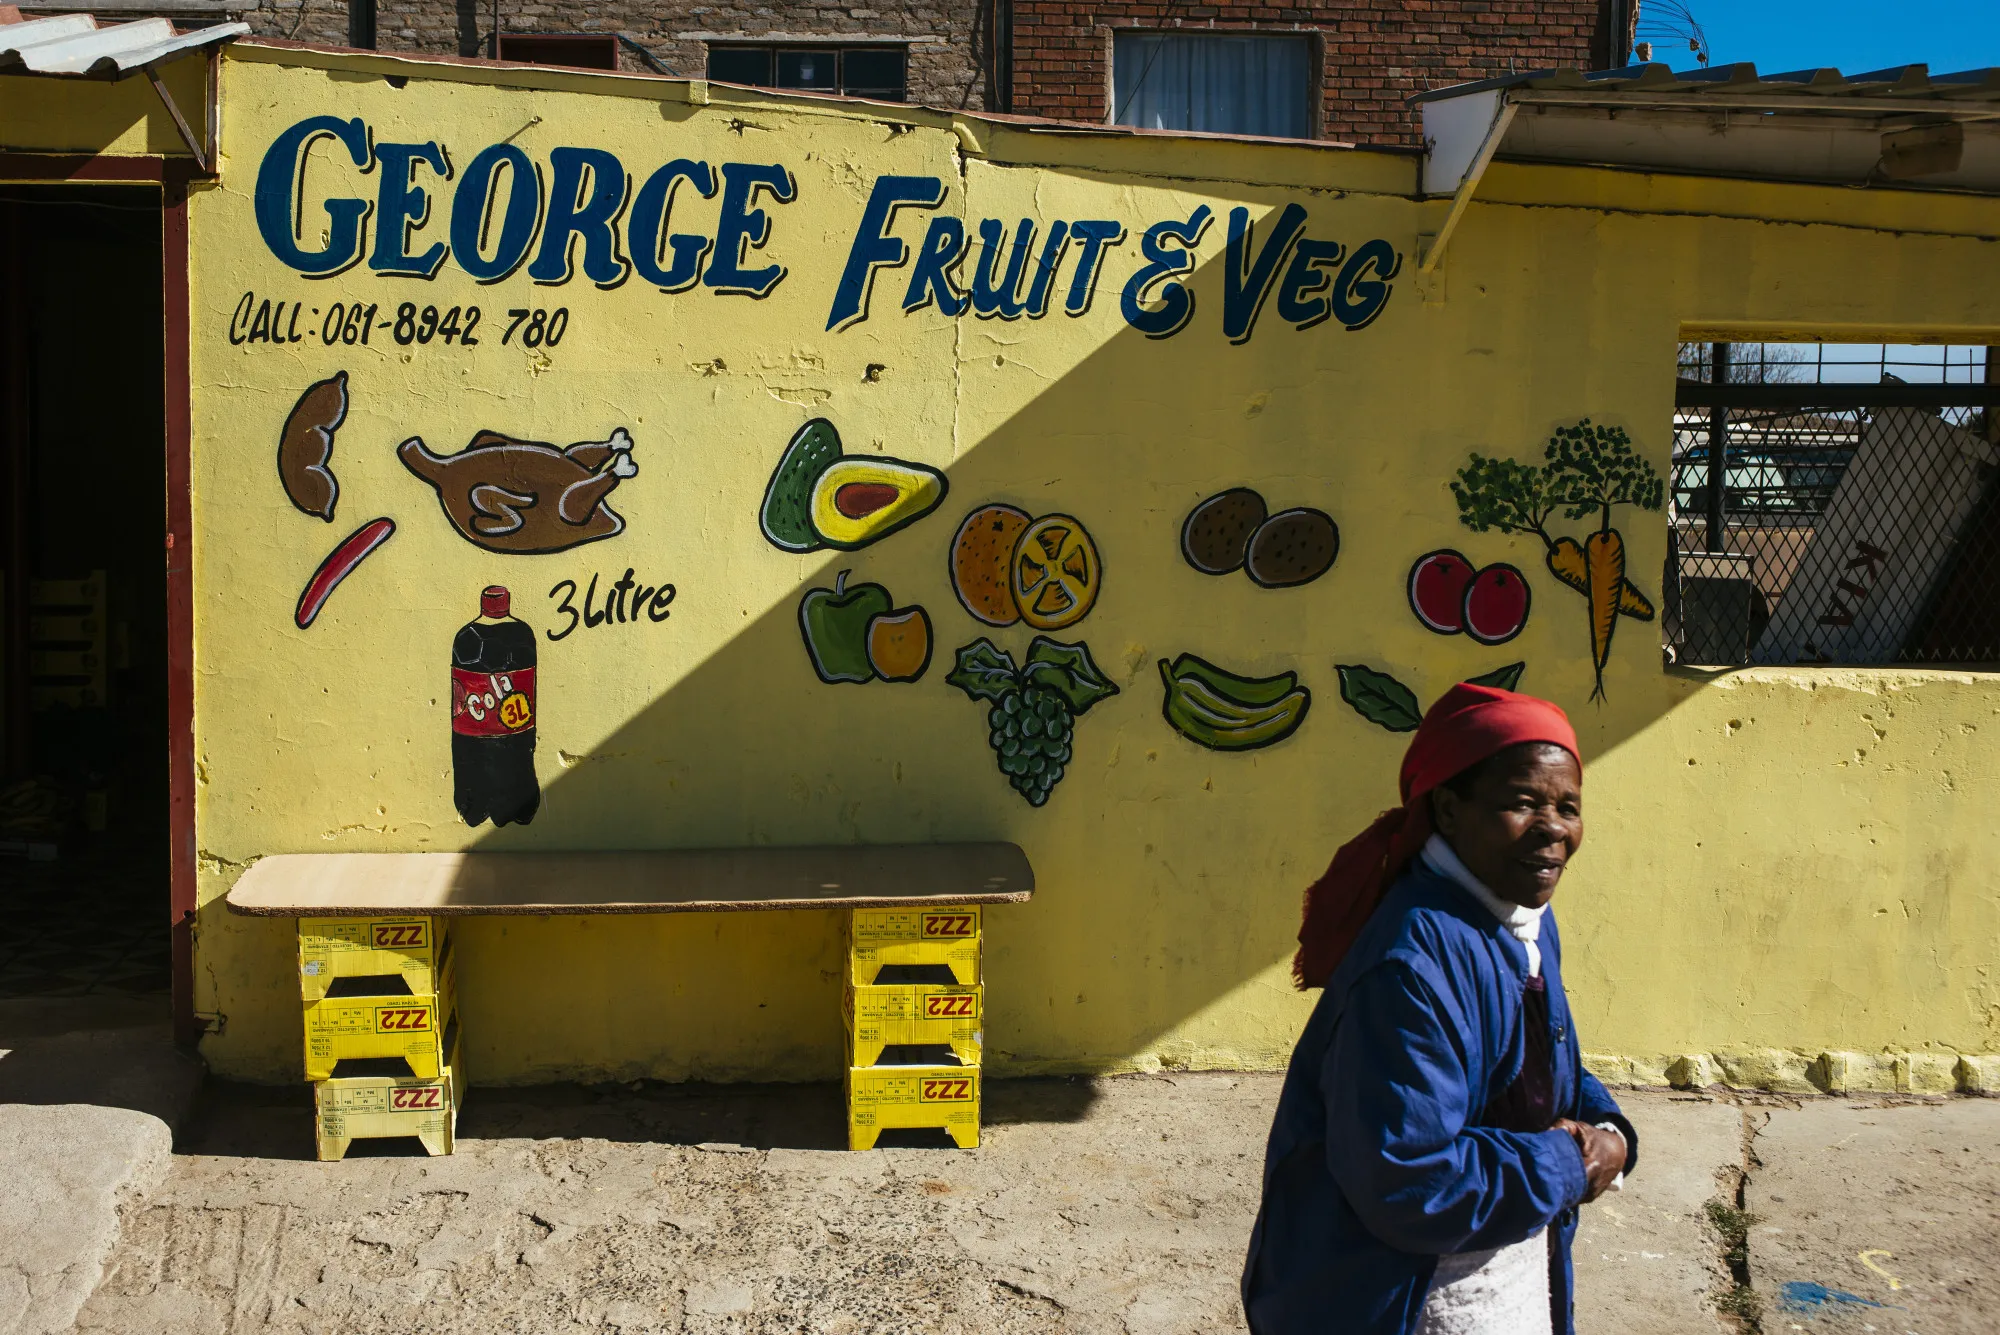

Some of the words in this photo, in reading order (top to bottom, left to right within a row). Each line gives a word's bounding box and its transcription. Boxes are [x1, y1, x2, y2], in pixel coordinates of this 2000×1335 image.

[255, 116, 797, 299] GEORGE
[825, 176, 1127, 333] FRUIT
[1121, 204, 1214, 340] &
[1222, 202, 1403, 346] VEG
[502, 307, 569, 348] 780
[467, 673, 513, 721] Cola
[505, 698, 529, 725] 3L
[376, 926, 422, 946] ZZ2
[926, 917, 971, 935] ZZ2
[929, 997, 973, 1015] ZZ2
[381, 1009, 426, 1029] ZZ2
[394, 1089, 439, 1109] ZZ2
[925, 1080, 969, 1099] ZZ2
